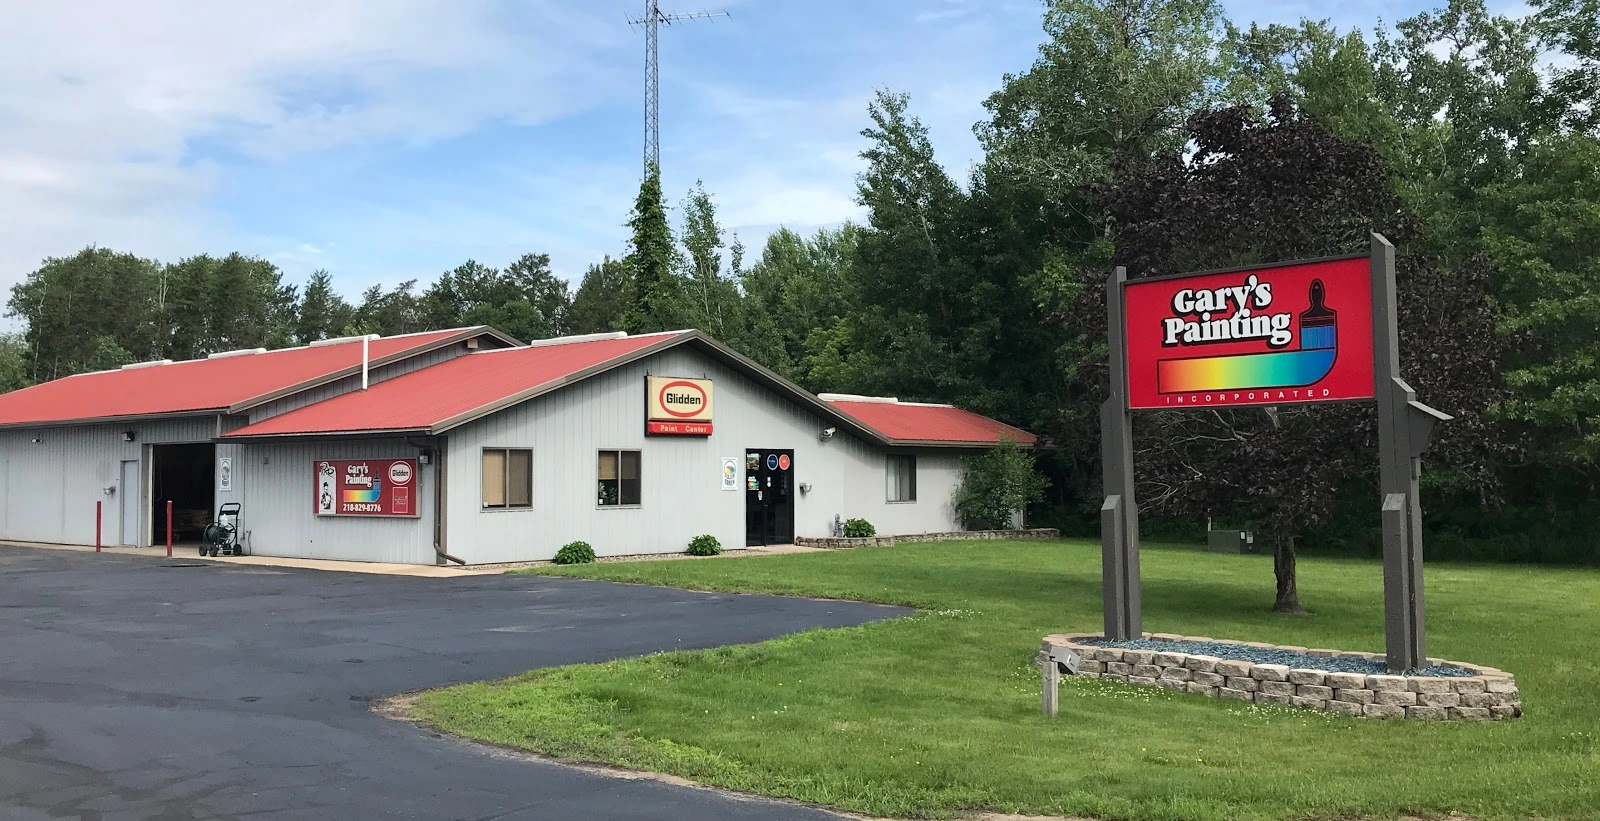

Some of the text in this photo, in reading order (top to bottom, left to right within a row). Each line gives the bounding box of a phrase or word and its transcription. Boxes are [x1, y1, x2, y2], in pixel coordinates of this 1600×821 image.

[1173, 275, 1272, 319] Gary's
[1164, 309, 1292, 345] Painting
[666, 393, 701, 405] Glidden
[1166, 389, 1330, 404] INCORPORATED
[660, 424, 707, 433] Paint Center
[347, 462, 369, 475] Gary's
[392, 469, 409, 477] Glidden
[345, 474, 373, 488] Painting
[342, 503, 382, 512] 218-829-8776
